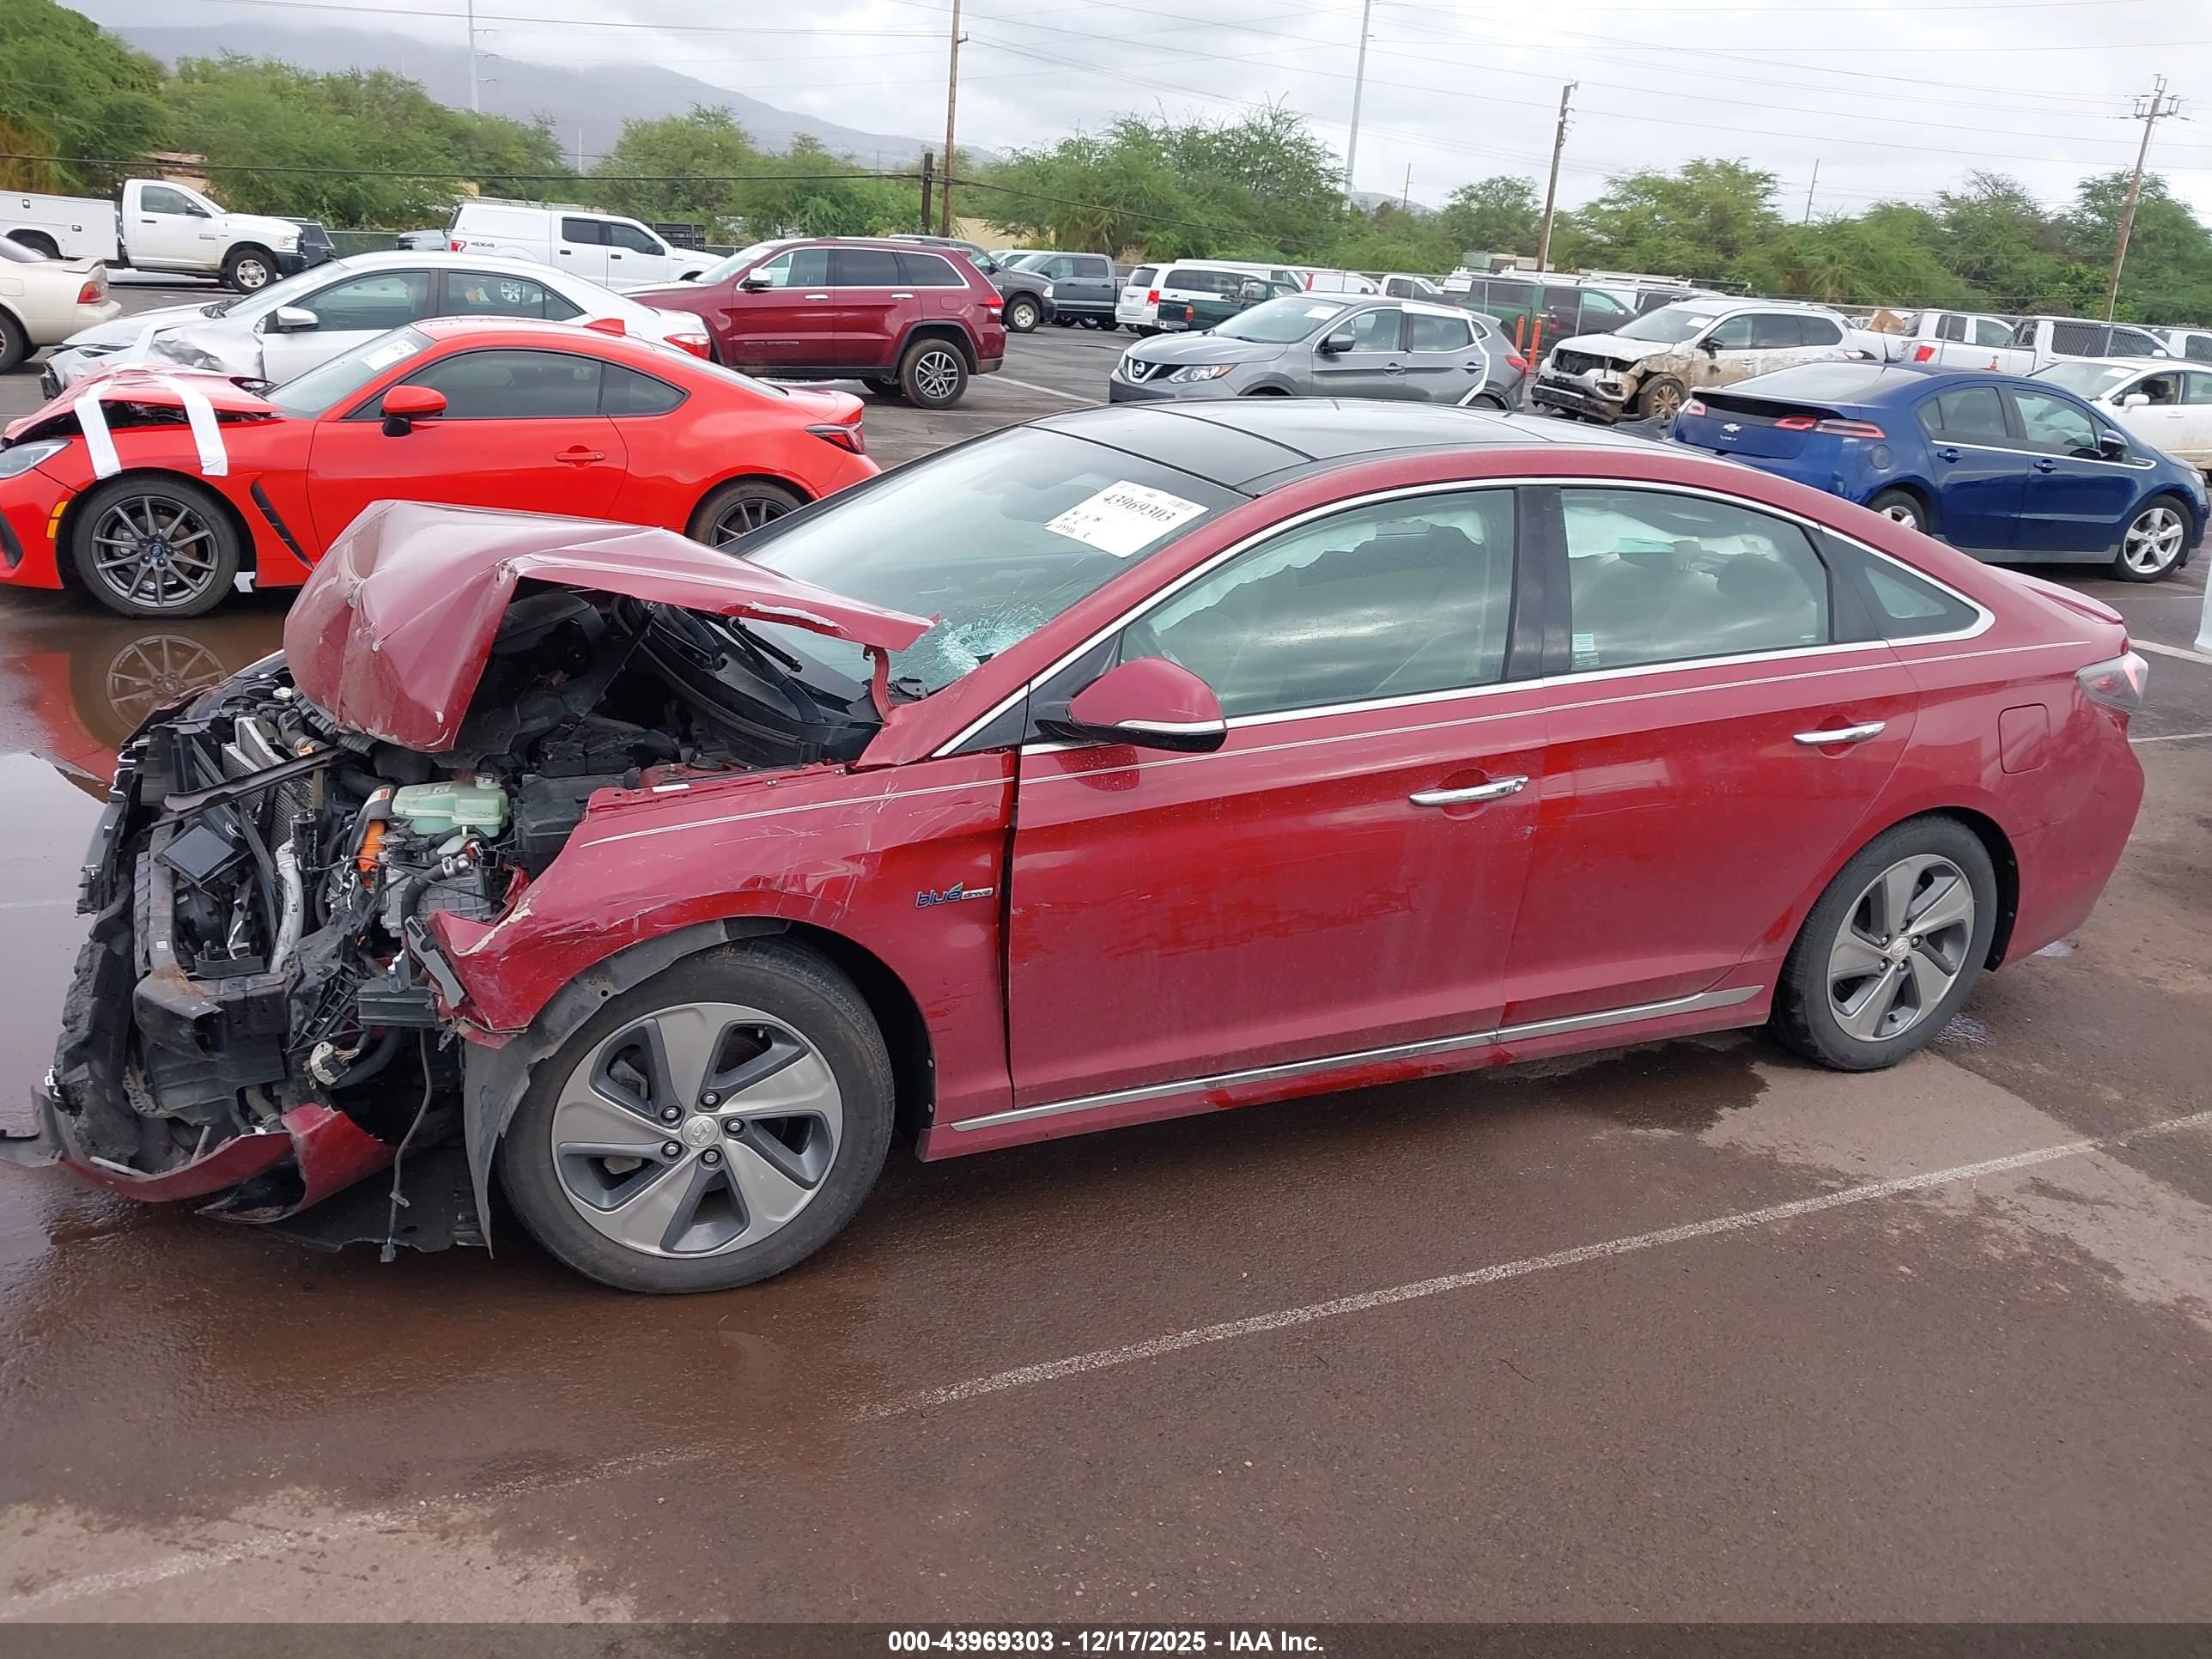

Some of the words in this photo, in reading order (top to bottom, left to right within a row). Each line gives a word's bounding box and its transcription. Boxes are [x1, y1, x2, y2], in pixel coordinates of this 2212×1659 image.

[1103, 494, 1177, 521] 43969303
[915, 885, 963, 908] blue
[963, 888, 993, 899] drive
